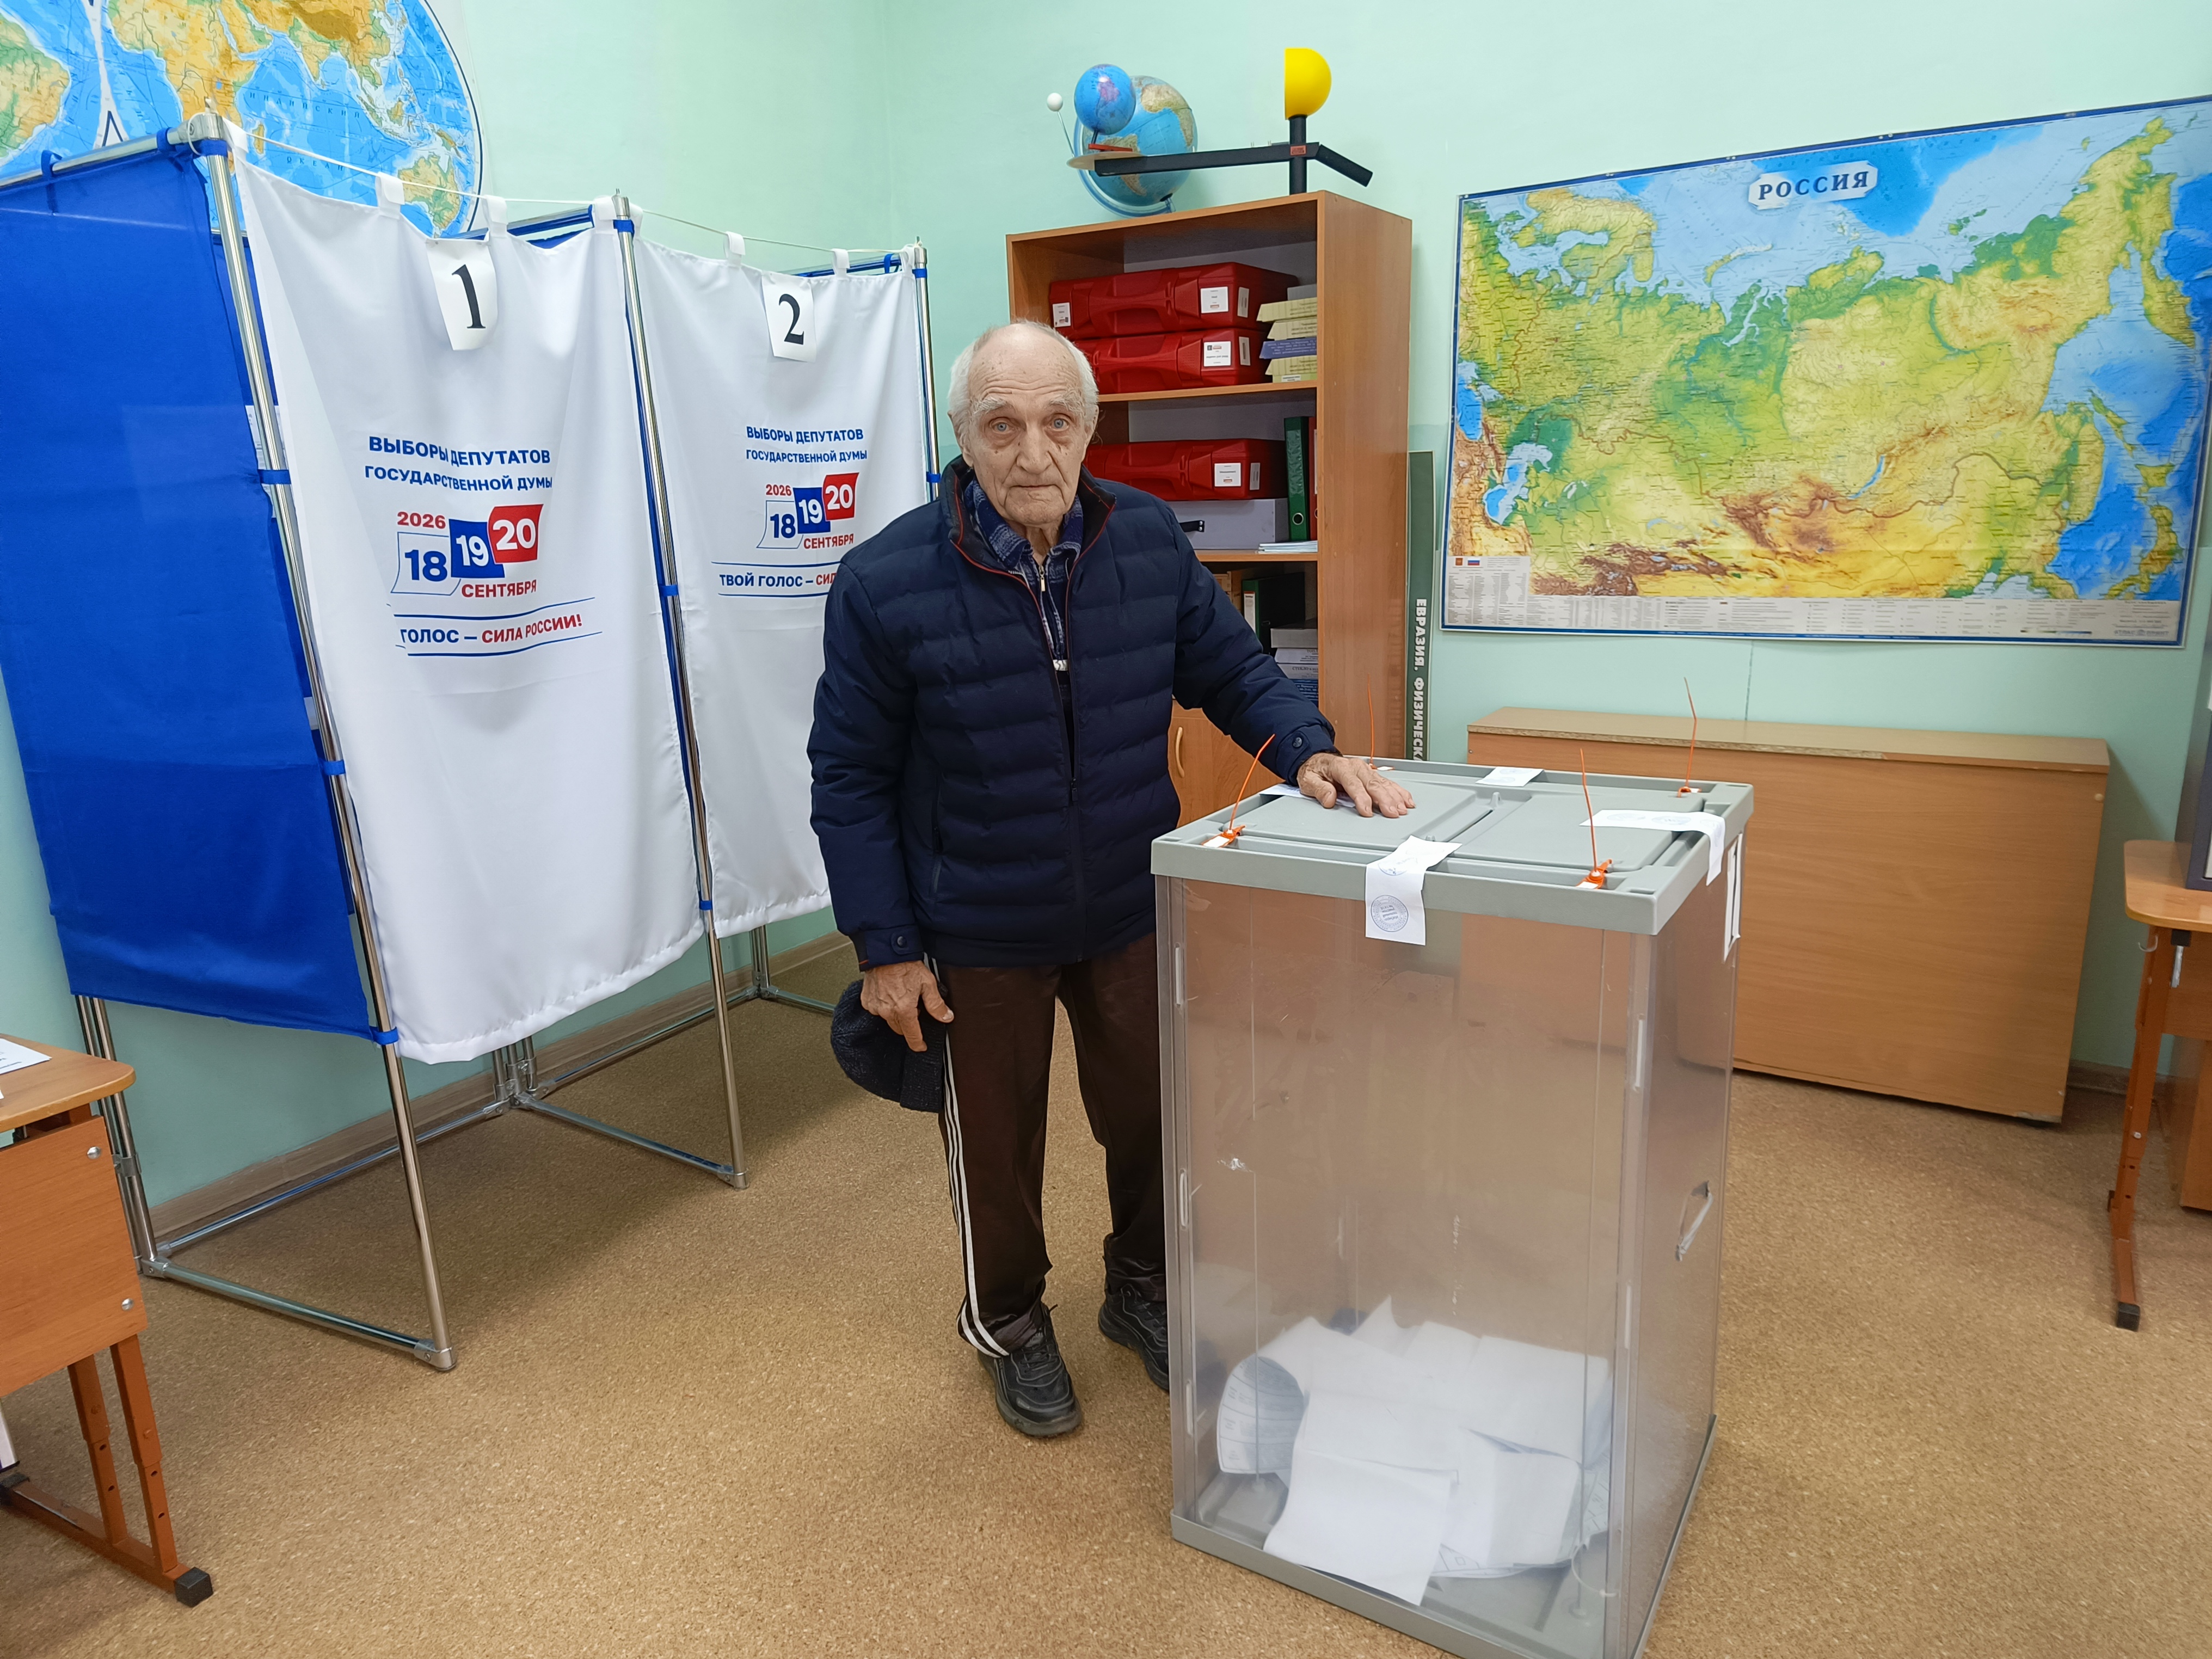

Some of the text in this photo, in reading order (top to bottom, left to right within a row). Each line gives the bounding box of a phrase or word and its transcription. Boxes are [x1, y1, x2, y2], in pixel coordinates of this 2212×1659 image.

[287, 156, 343, 171] ОКЕАН
[1758, 171, 1869, 200] РОССИЯ
[452, 264, 486, 328] 1
[779, 294, 804, 345] 2
[746, 426, 864, 444] ВЫБОРЫ ДЕПУТАТОВ
[369, 436, 551, 467] ВЫБОРЫ ДЕПУТАТОВ
[746, 450, 868, 463] ГОСУДАРСТВЕННОЙ ДУМЫ
[365, 465, 552, 490] ГОСУДАРСТВЕННОЙ ДУМЫ
[766, 484, 792, 496] 2026
[397, 512, 446, 529] 2026
[770, 484, 853, 538] 18 19 20
[404, 518, 536, 582] 18 19 20
[803, 533, 854, 549] СЕНТЯБРЯ
[462, 579, 537, 598] СЕНТЯБРЯ
[720, 572, 754, 586] ТВОЙ
[758, 576, 803, 587] ГОЛОС
[816, 573, 837, 586] СИЛ
[400, 629, 459, 643] ГОЛОС
[482, 628, 523, 643] СИЛА
[525, 614, 582, 638] РОССИИ!
[1414, 599, 1427, 671] ЕВРАЗИЯ.
